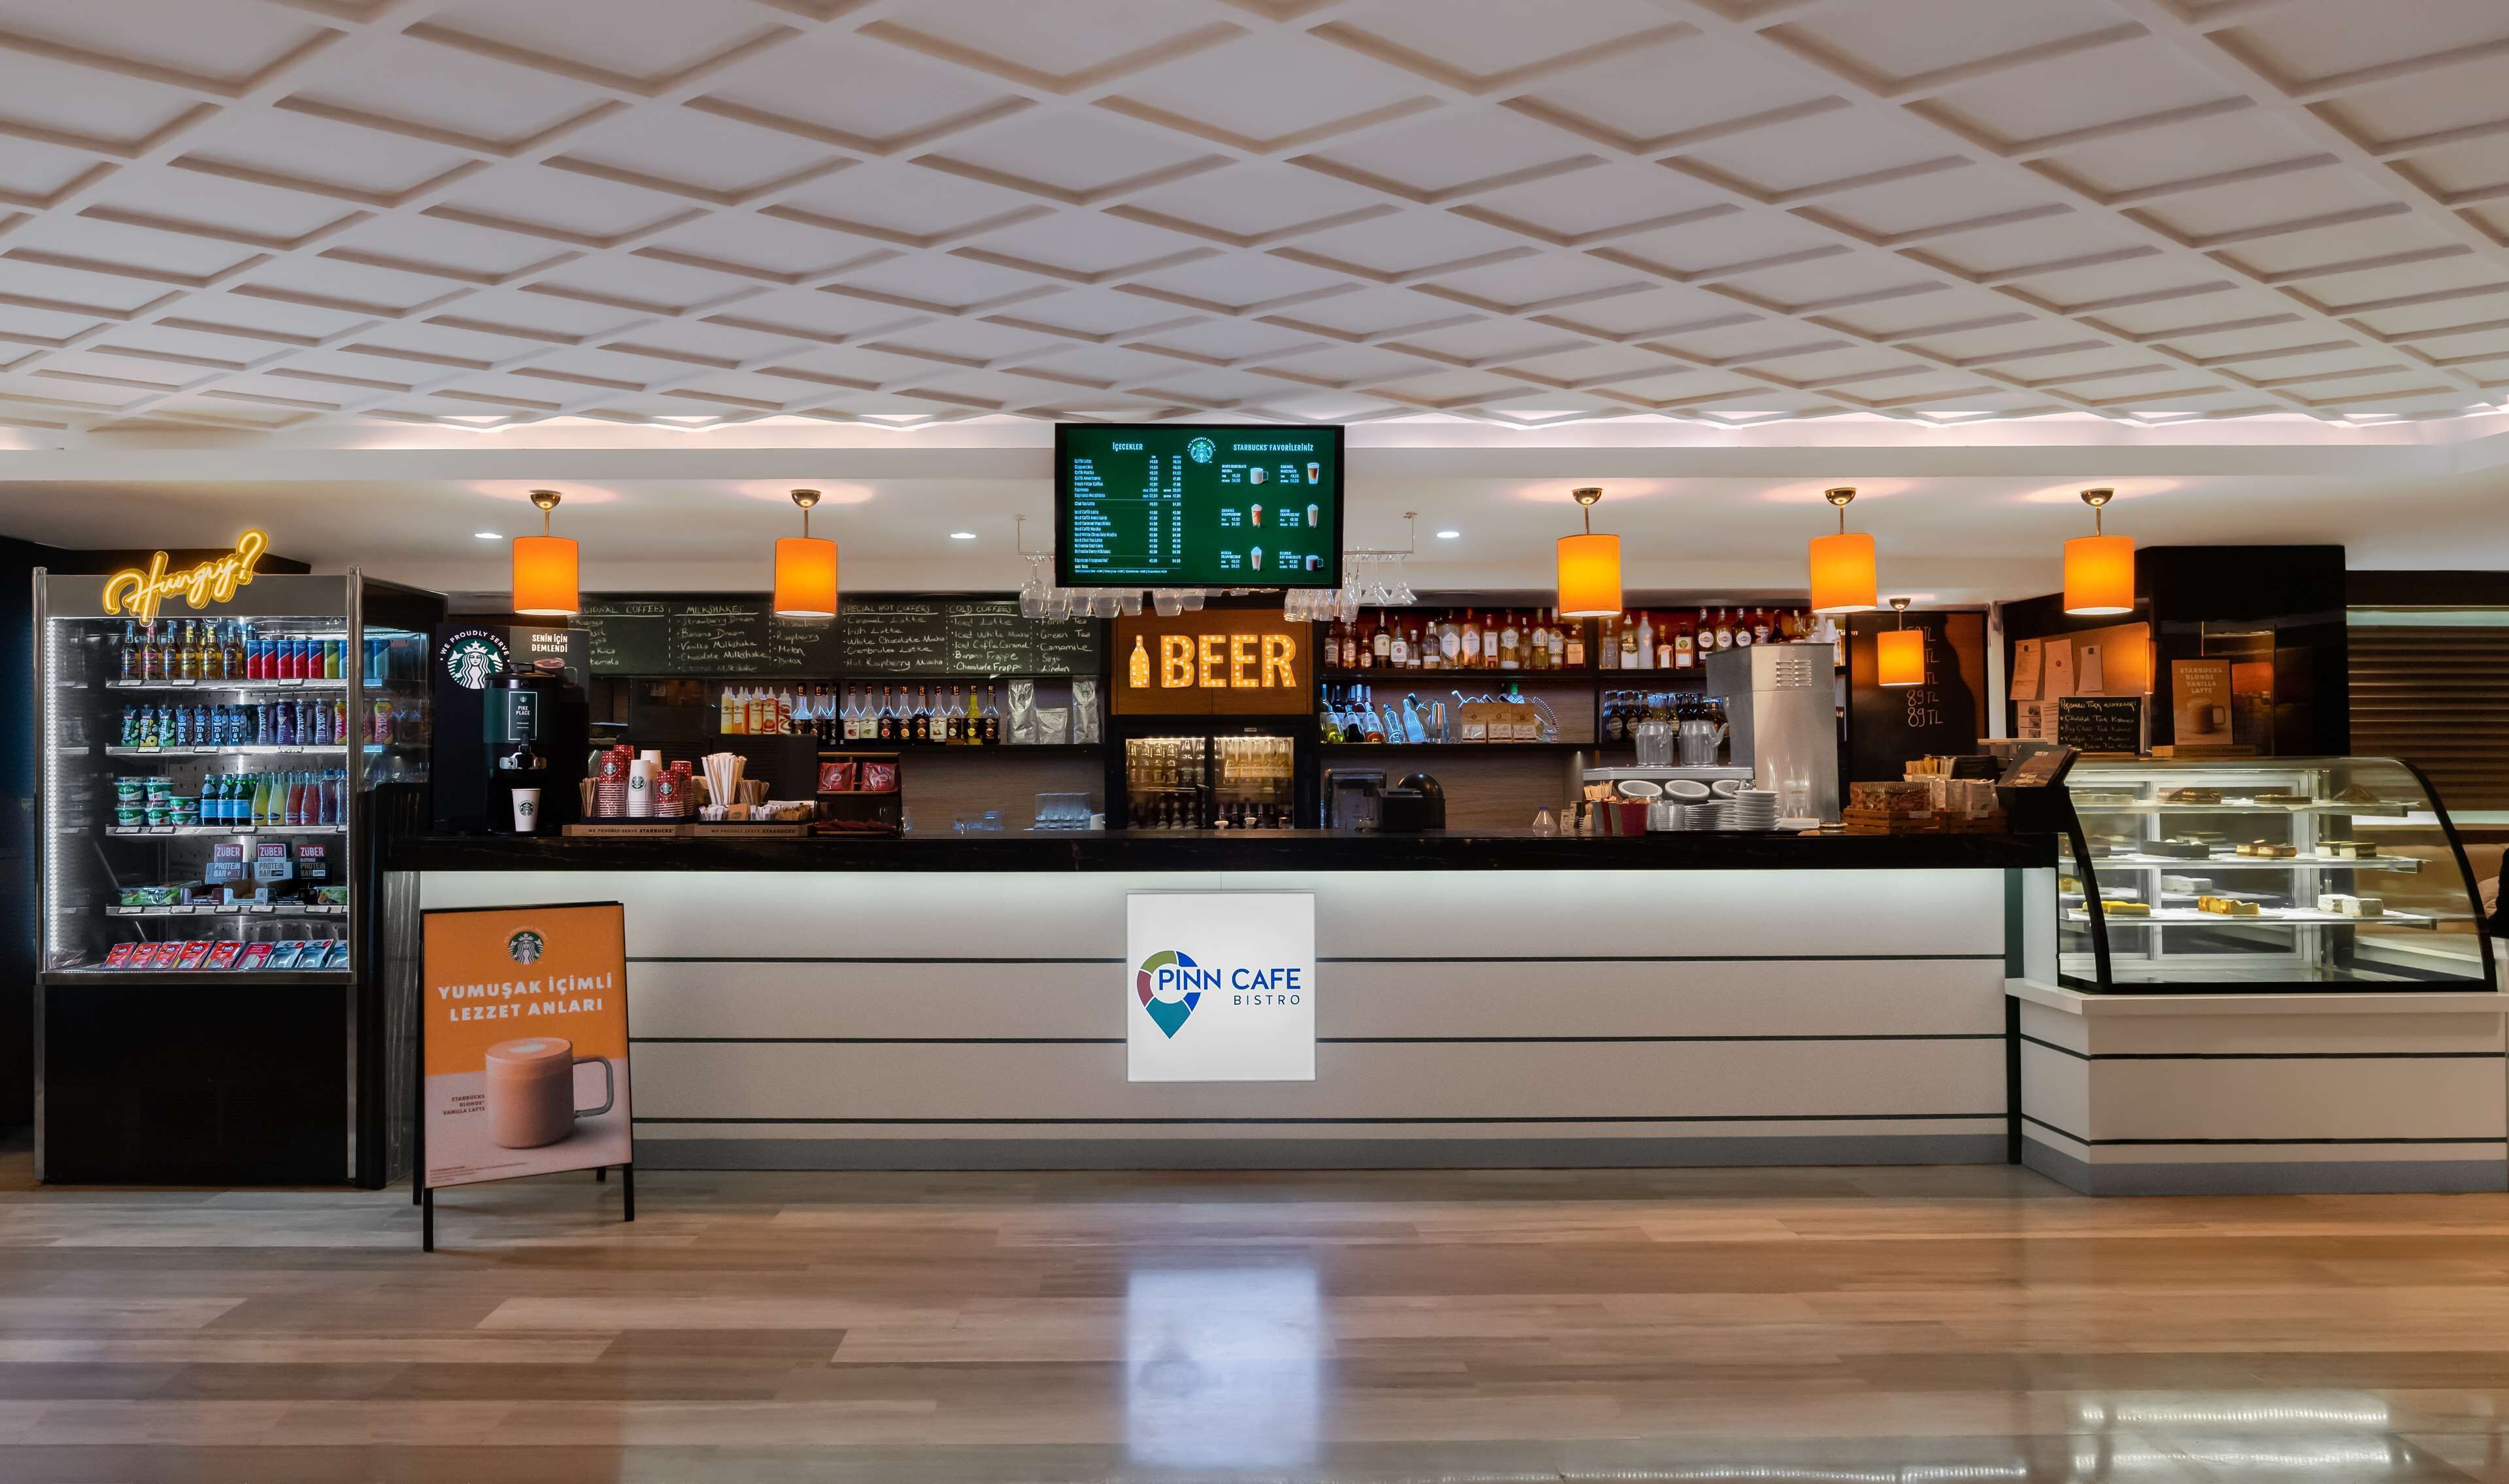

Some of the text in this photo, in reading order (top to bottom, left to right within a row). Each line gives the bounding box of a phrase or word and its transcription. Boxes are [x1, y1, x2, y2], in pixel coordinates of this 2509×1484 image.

[1113, 442, 1143, 451] İÇECEKLER
[1270, 443, 1313, 451] FAVORİLERİNİZ
[103, 530, 268, 624] Hungry?
[578, 605, 620, 615] EGIONAL
[949, 605, 973, 614] COLD
[681, 628, 711, 638] Banana
[1040, 629, 1068, 639] Green
[439, 630, 510, 656] WE PROUDLY SERVE
[532, 633, 568, 645] SENİN İÇİN
[531, 643, 568, 653] DEMLENDİ
[681, 641, 709, 650] Vanilla
[723, 650, 769, 659] Milkshake
[1160, 634, 1297, 688] BEER
[1907, 690, 1940, 706] 89 TL
[1908, 707, 1944, 727] 89 TL
[1158, 968, 1301, 990] PINN CAFE
[438, 972, 612, 1000] YUMUŞAK İÇİMLİ
[1234, 994, 1300, 1005] BISTRO
[450, 998, 602, 1022] LEZZET ANLARI
